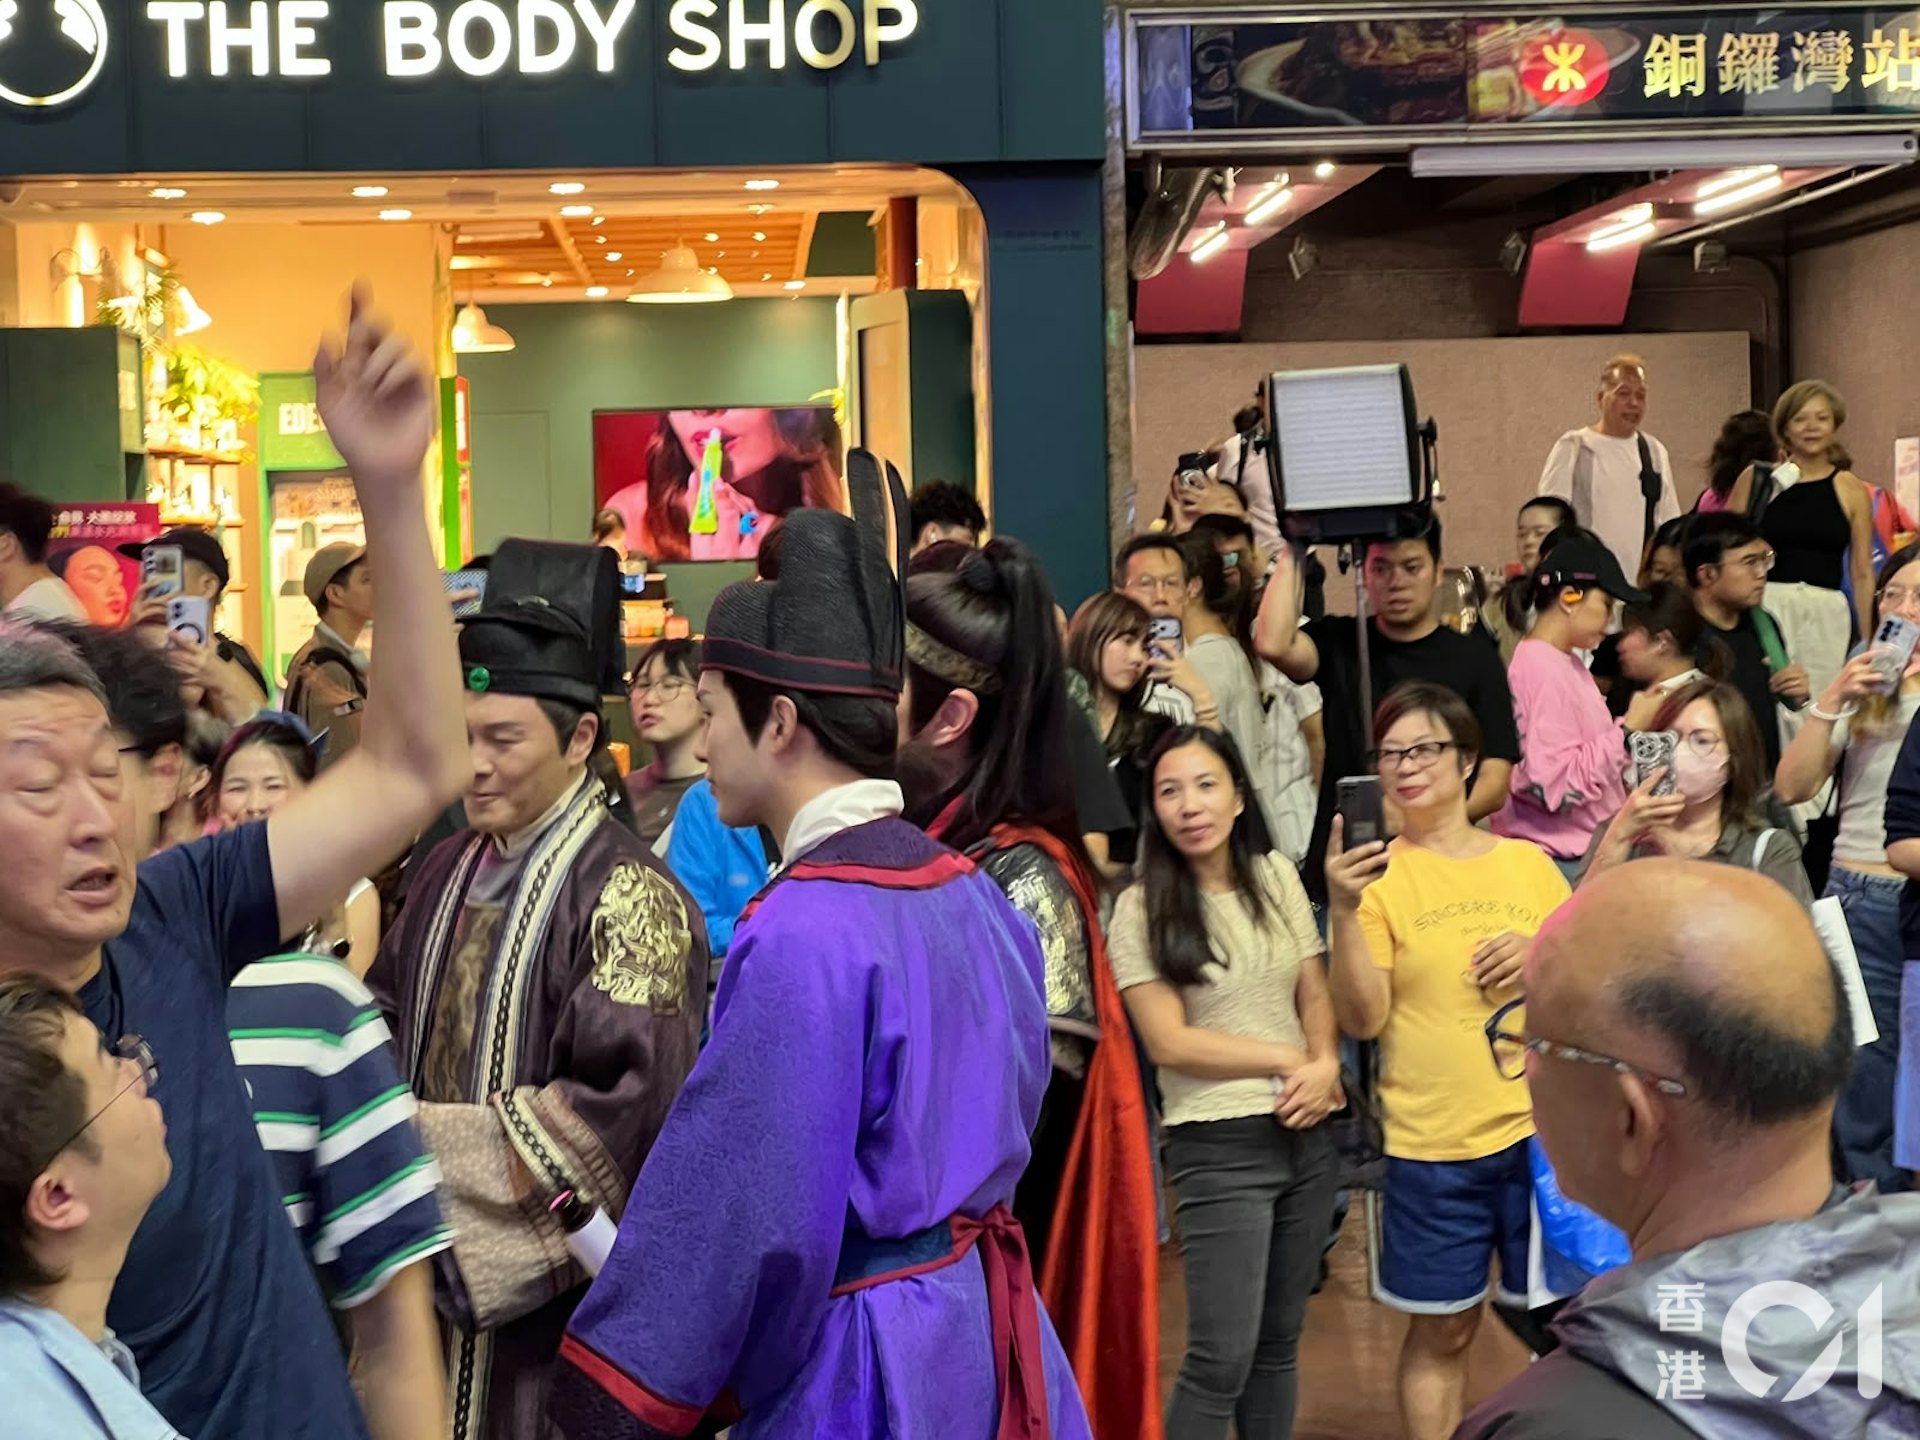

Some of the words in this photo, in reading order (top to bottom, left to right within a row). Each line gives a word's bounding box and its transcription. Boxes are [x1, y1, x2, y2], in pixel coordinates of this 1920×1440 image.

[147, 0, 332, 78] THE
[384, 0, 634, 77] BODY
[667, 0, 920, 71] SHOP
[1643, 28, 1920, 98] 銅鑼灣站
[279, 402, 327, 435] EDE
[1412, 900, 1501, 932] SINCERE
